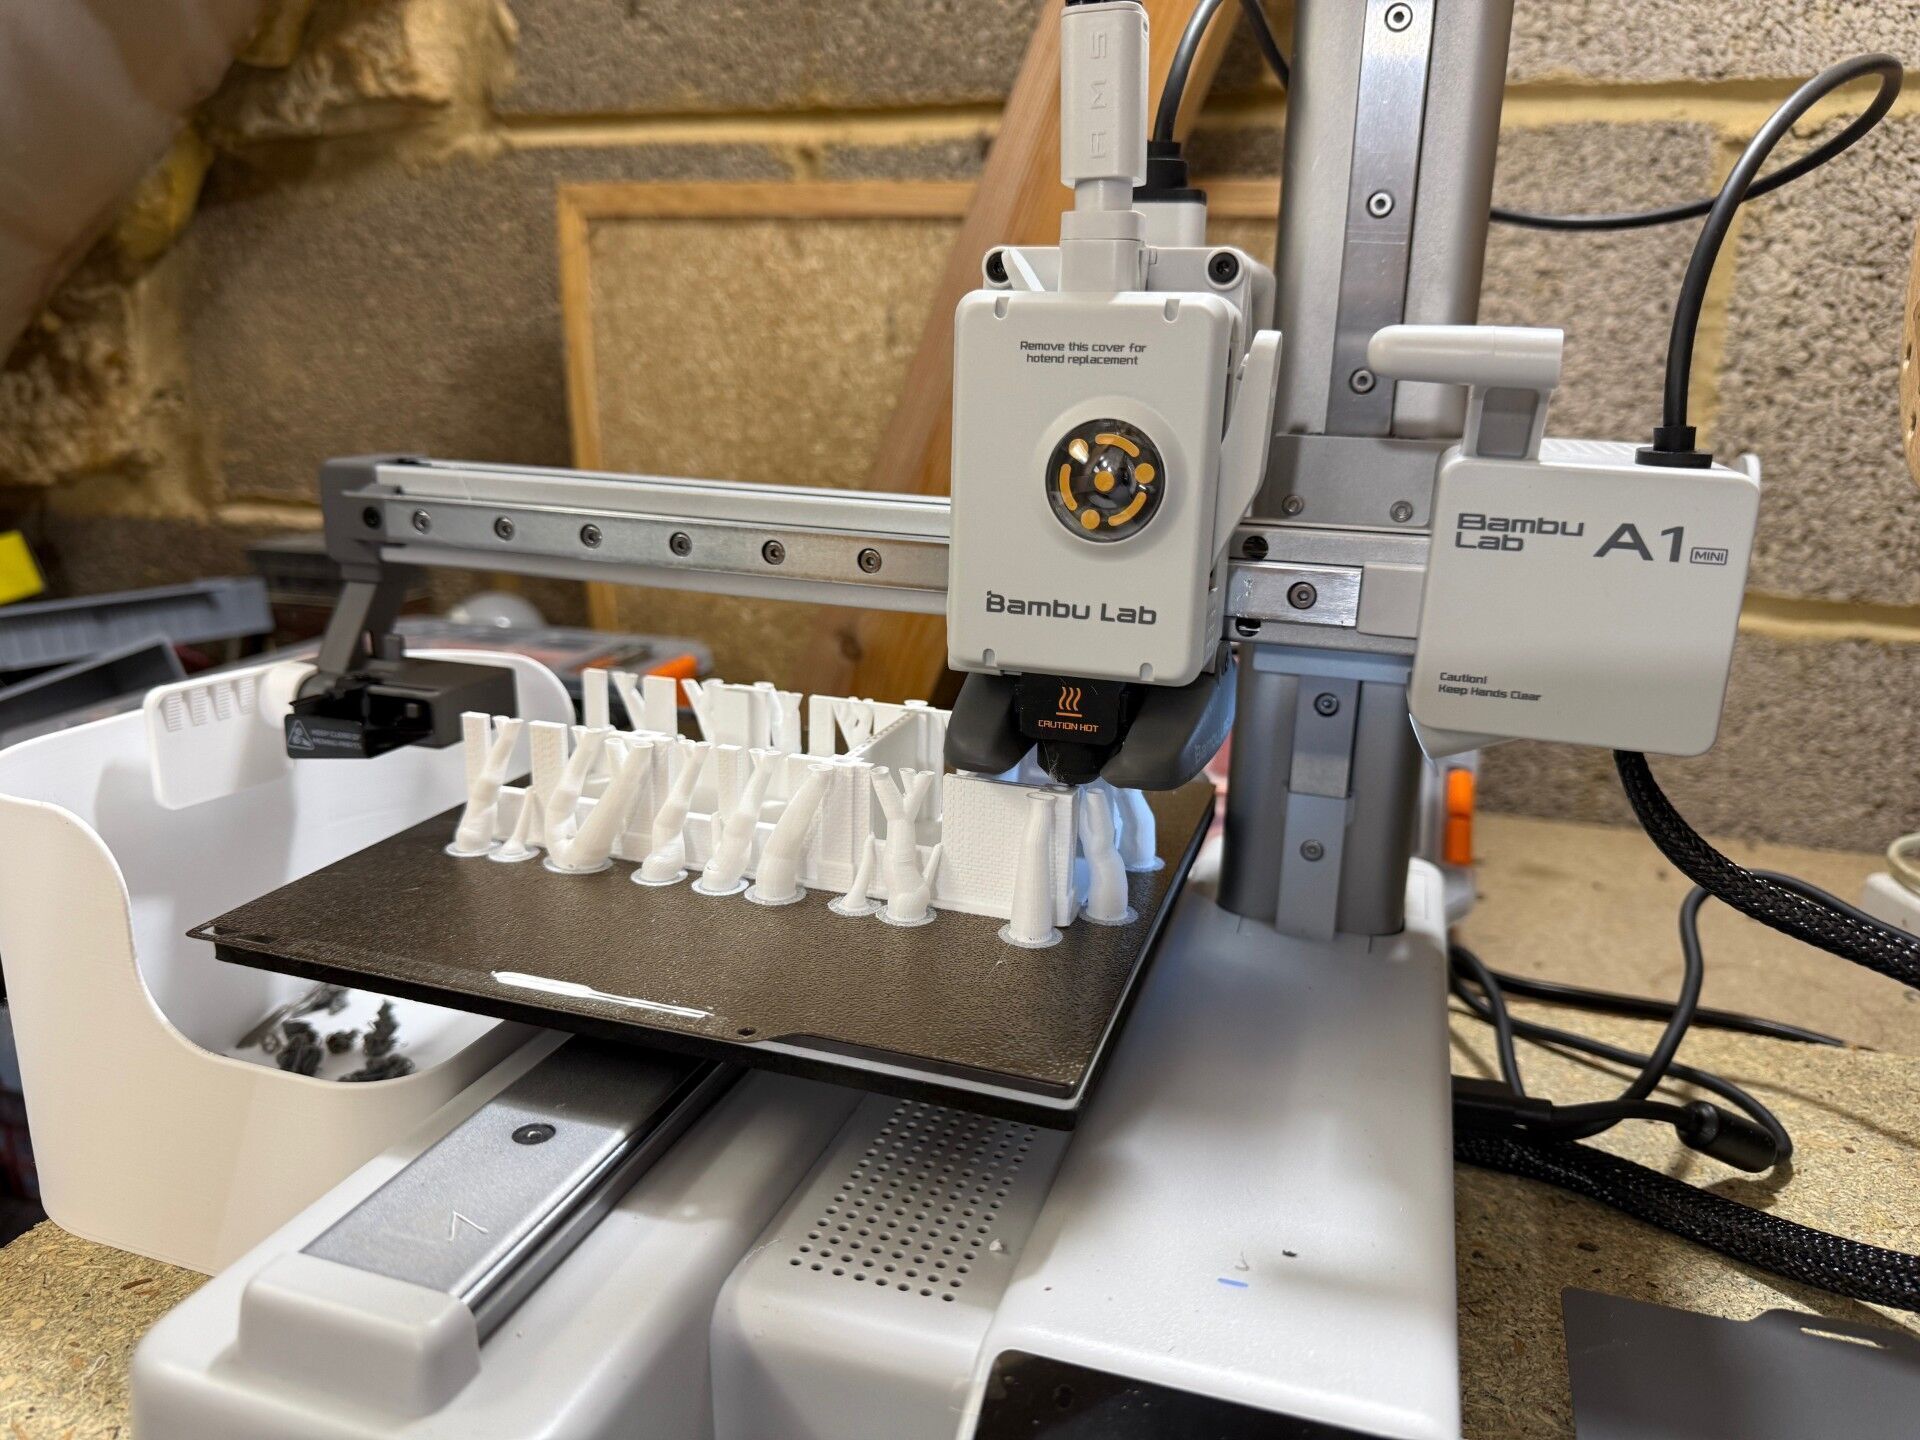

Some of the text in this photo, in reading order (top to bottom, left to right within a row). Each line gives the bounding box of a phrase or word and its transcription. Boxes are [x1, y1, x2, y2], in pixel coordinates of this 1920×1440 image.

[1020, 340, 1147, 353] Remove this cover for
[1026, 354, 1139, 366] hotend replacement
[1457, 513, 1585, 537] Bambu
[1455, 532, 1525, 552] Lab
[1593, 523, 1726, 563] A1 MINI
[986, 590, 1158, 626] Bambu Lab
[1439, 671, 1488, 684] Caution!
[1438, 684, 1542, 701] Keep Hands Clear
[1038, 719, 1100, 733] CAUTION HOT
